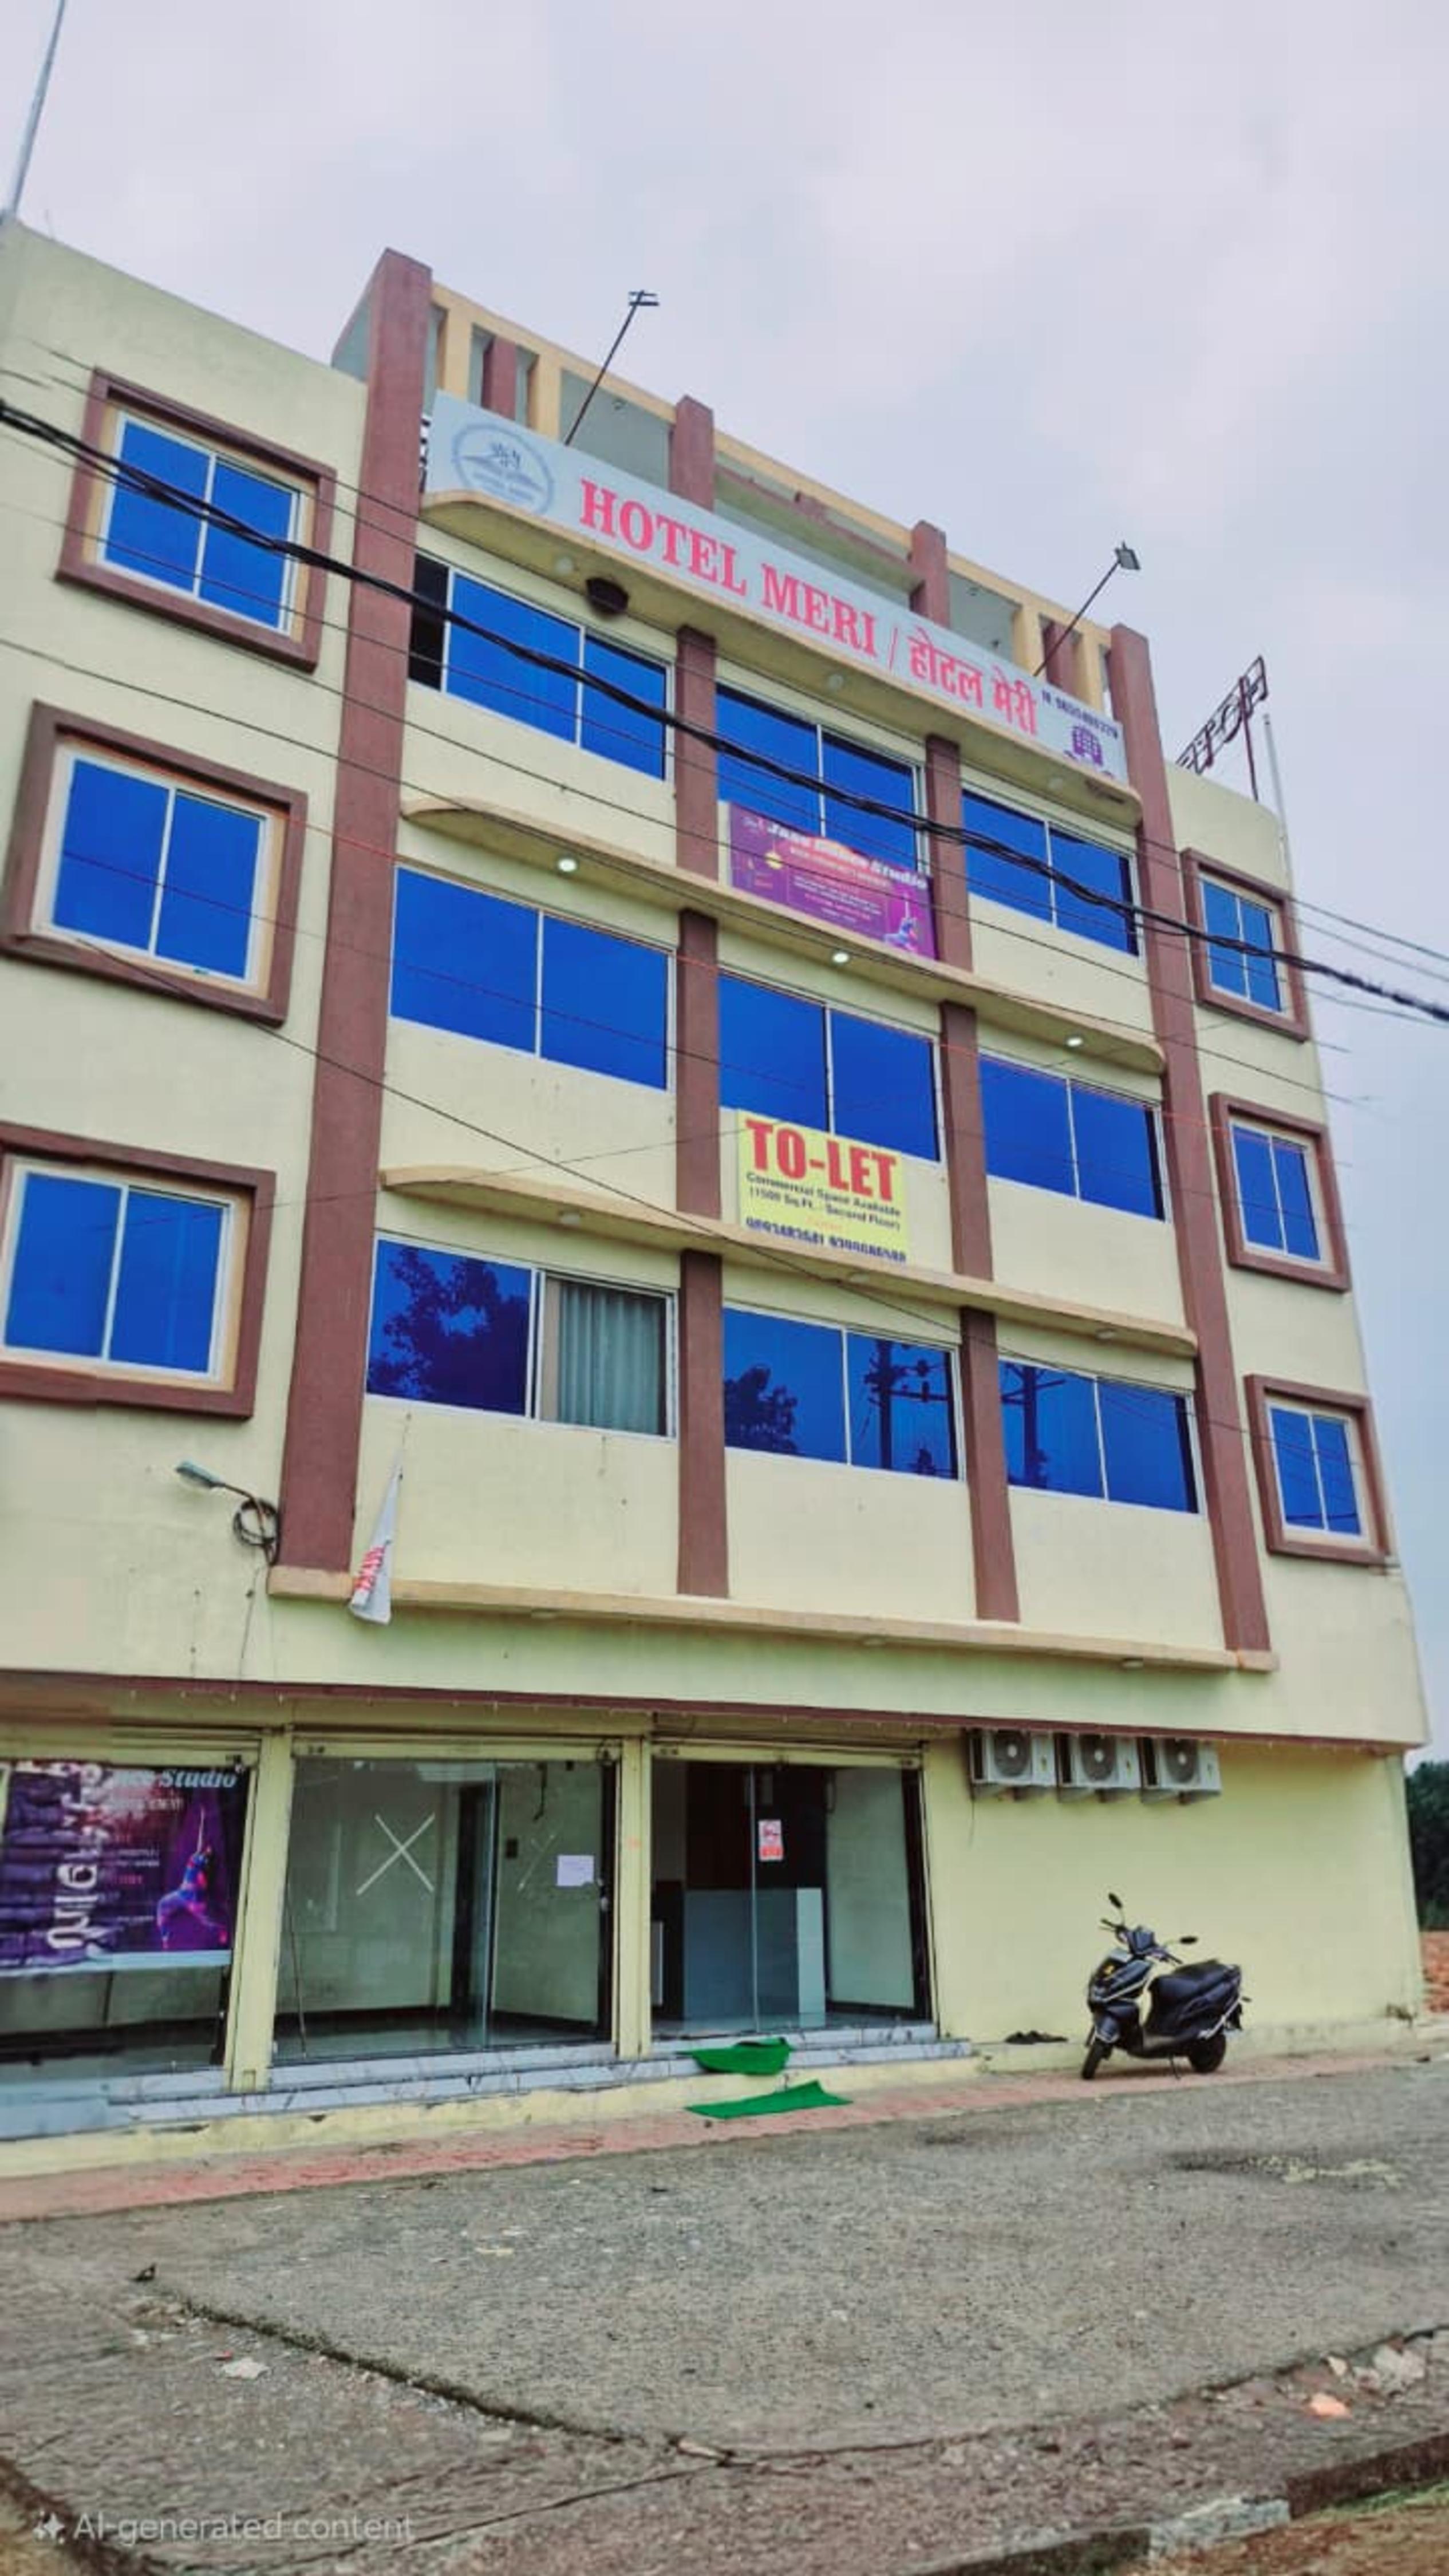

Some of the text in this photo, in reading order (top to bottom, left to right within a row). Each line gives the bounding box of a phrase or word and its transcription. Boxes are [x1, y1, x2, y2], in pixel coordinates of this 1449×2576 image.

[580, 479, 747, 596] HOTEL
[761, 563, 877, 658] MERI
[907, 625, 984, 709] होटल
[991, 666, 1038, 736] मेरी
[745, 1118, 897, 1203] TO-LET
[746, 1172, 814, 1196] Commercial
[816, 1187, 850, 1206] Space
[159, 1768, 237, 1788] Studio
